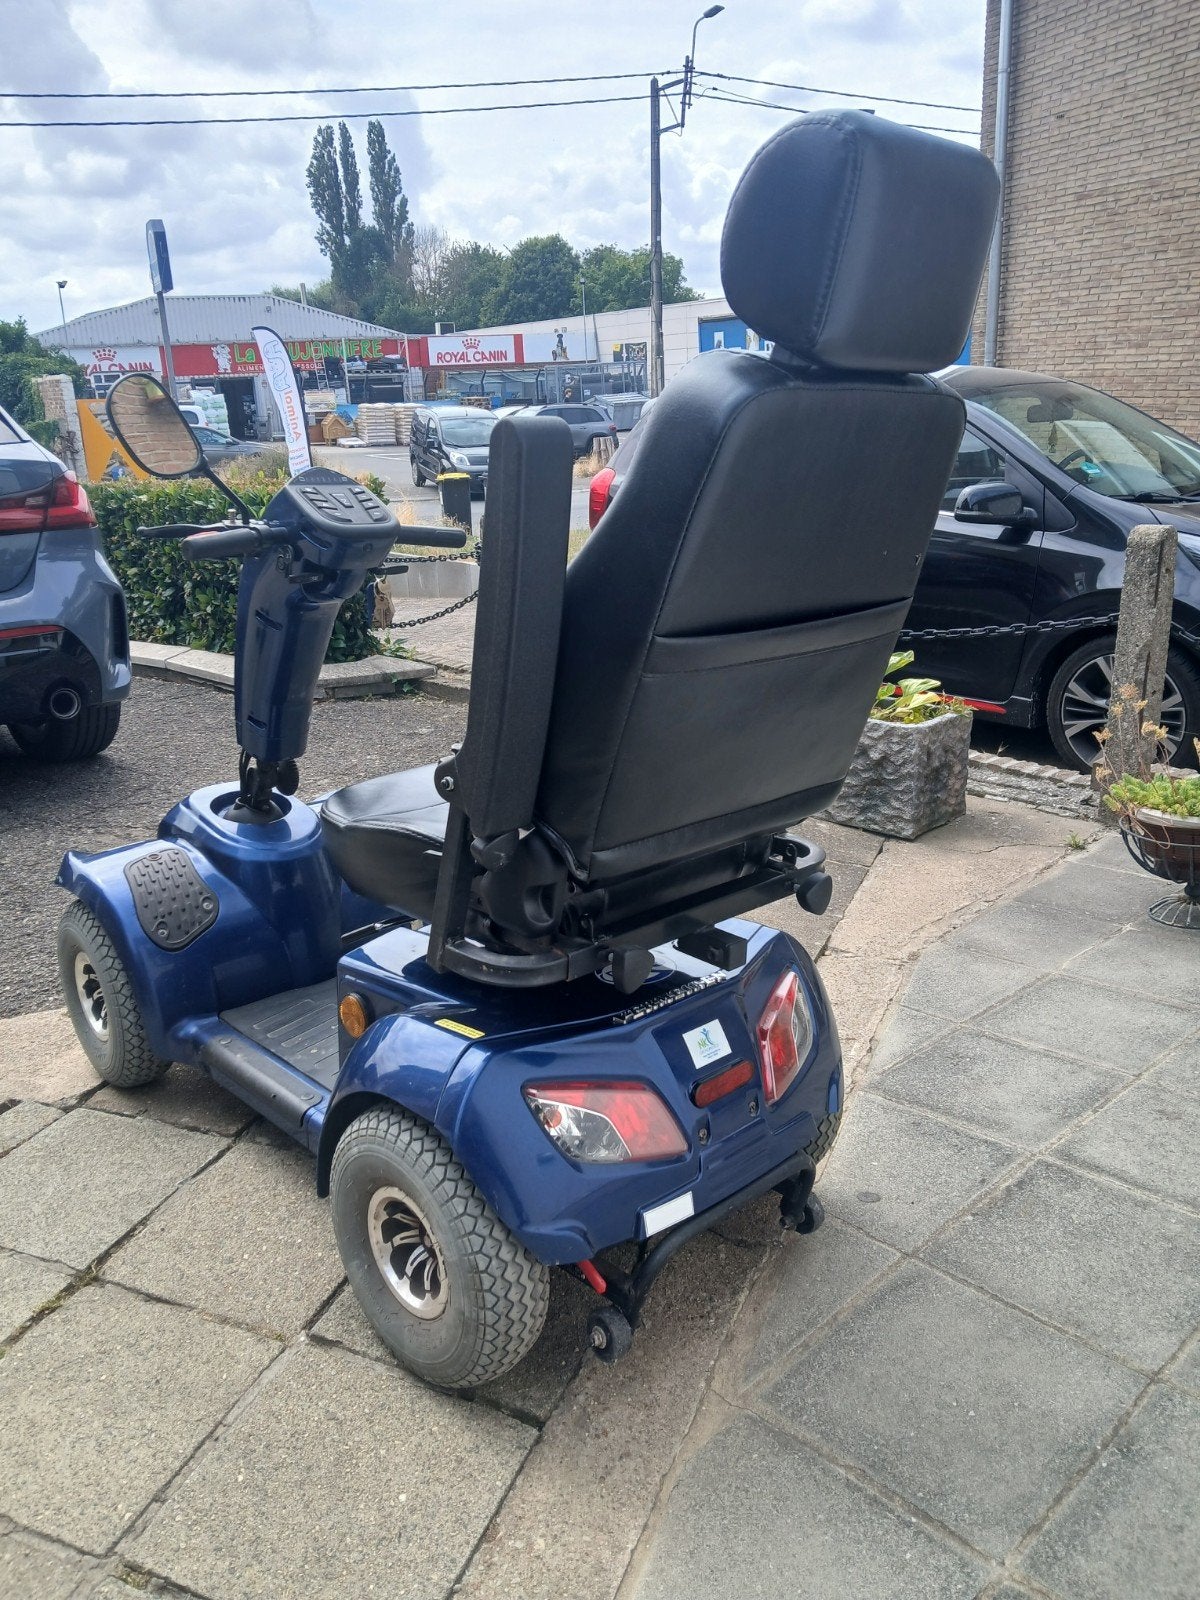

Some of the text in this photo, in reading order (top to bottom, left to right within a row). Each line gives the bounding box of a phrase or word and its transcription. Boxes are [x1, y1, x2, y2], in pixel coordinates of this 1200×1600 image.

[234, 343, 255, 362] La
[436, 350, 508, 363] ROYAL CANIN
[108, 362, 155, 372] CANIN
